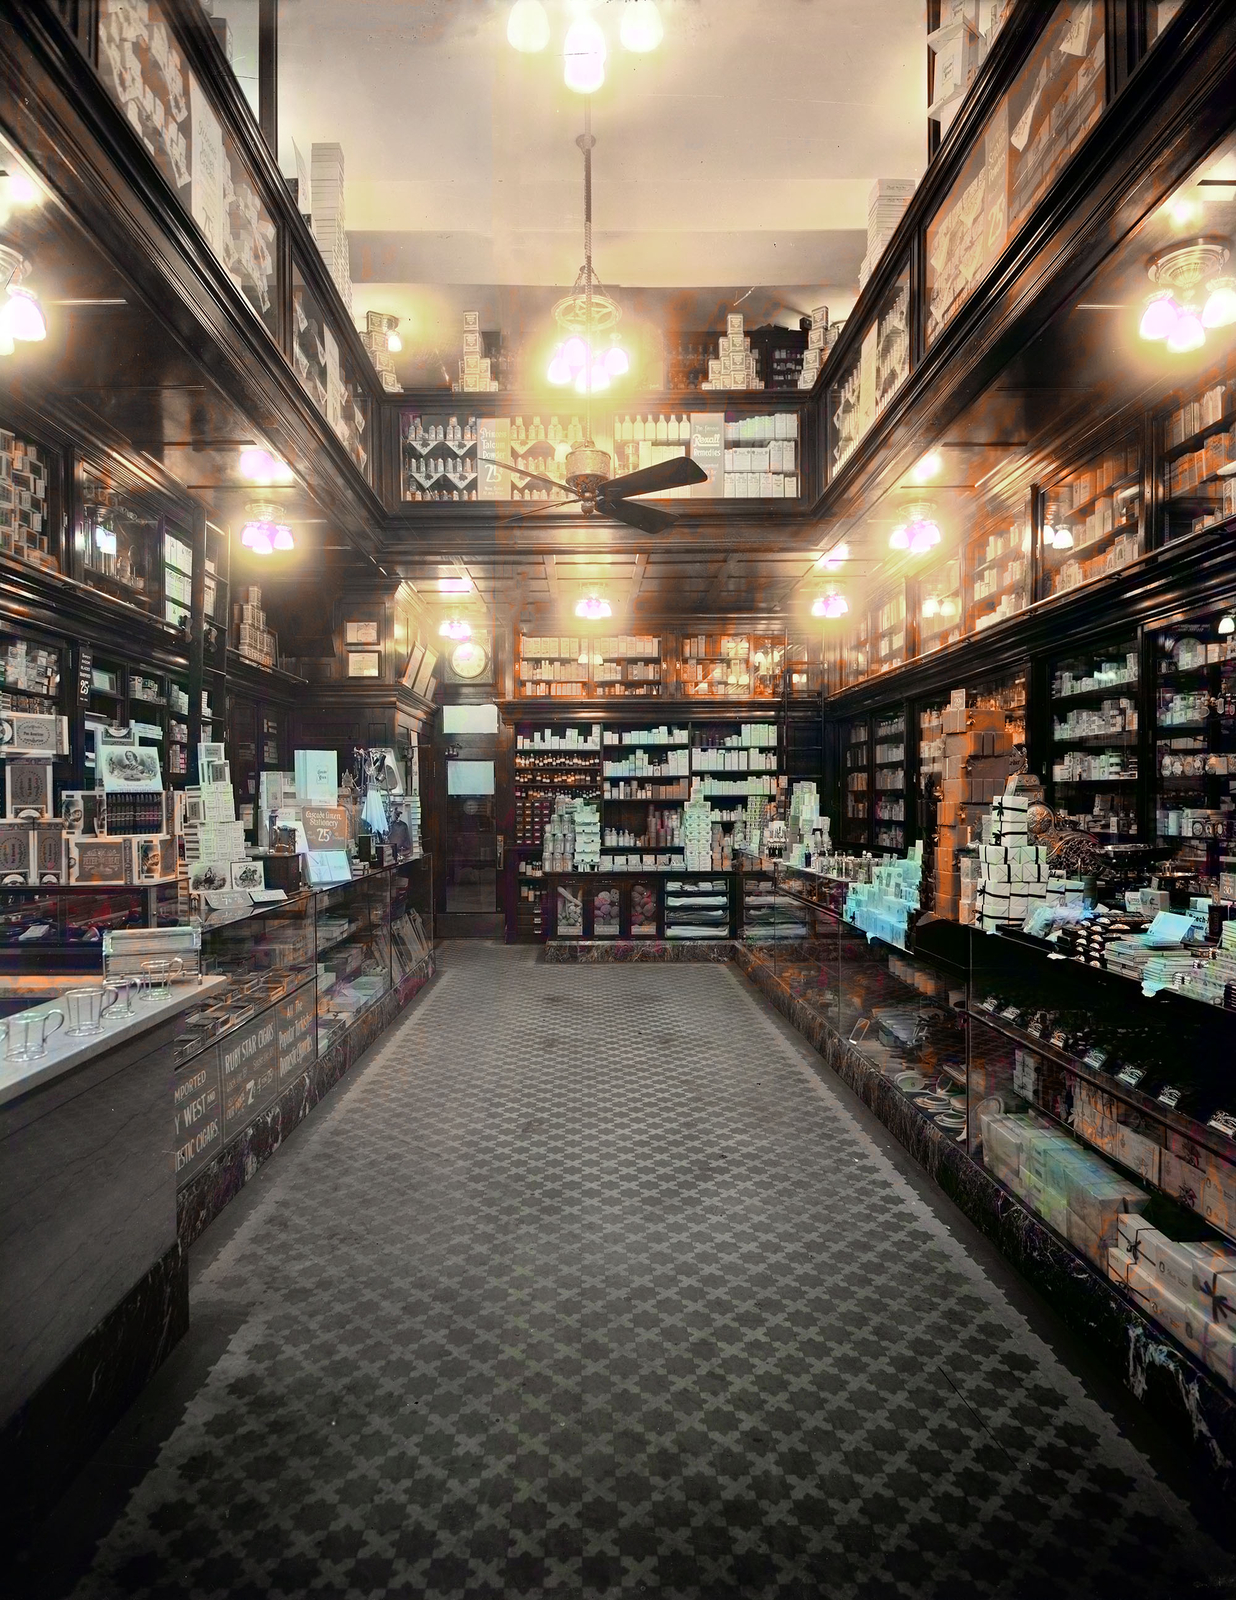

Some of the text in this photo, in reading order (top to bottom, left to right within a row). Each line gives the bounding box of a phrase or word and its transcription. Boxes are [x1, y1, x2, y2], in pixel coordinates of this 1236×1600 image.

[692, 433, 721, 447] Rexall
[693, 448, 721, 457] Remedies
[309, 818, 339, 829] Stationery
[225, 1022, 274, 1074] RUBY STAR CIGARS
[174, 1070, 206, 1104] MPORTED
[184, 1094, 206, 1128] WEST
[207, 1091, 216, 1105] AND
[175, 1138, 195, 1172] ESTIC
